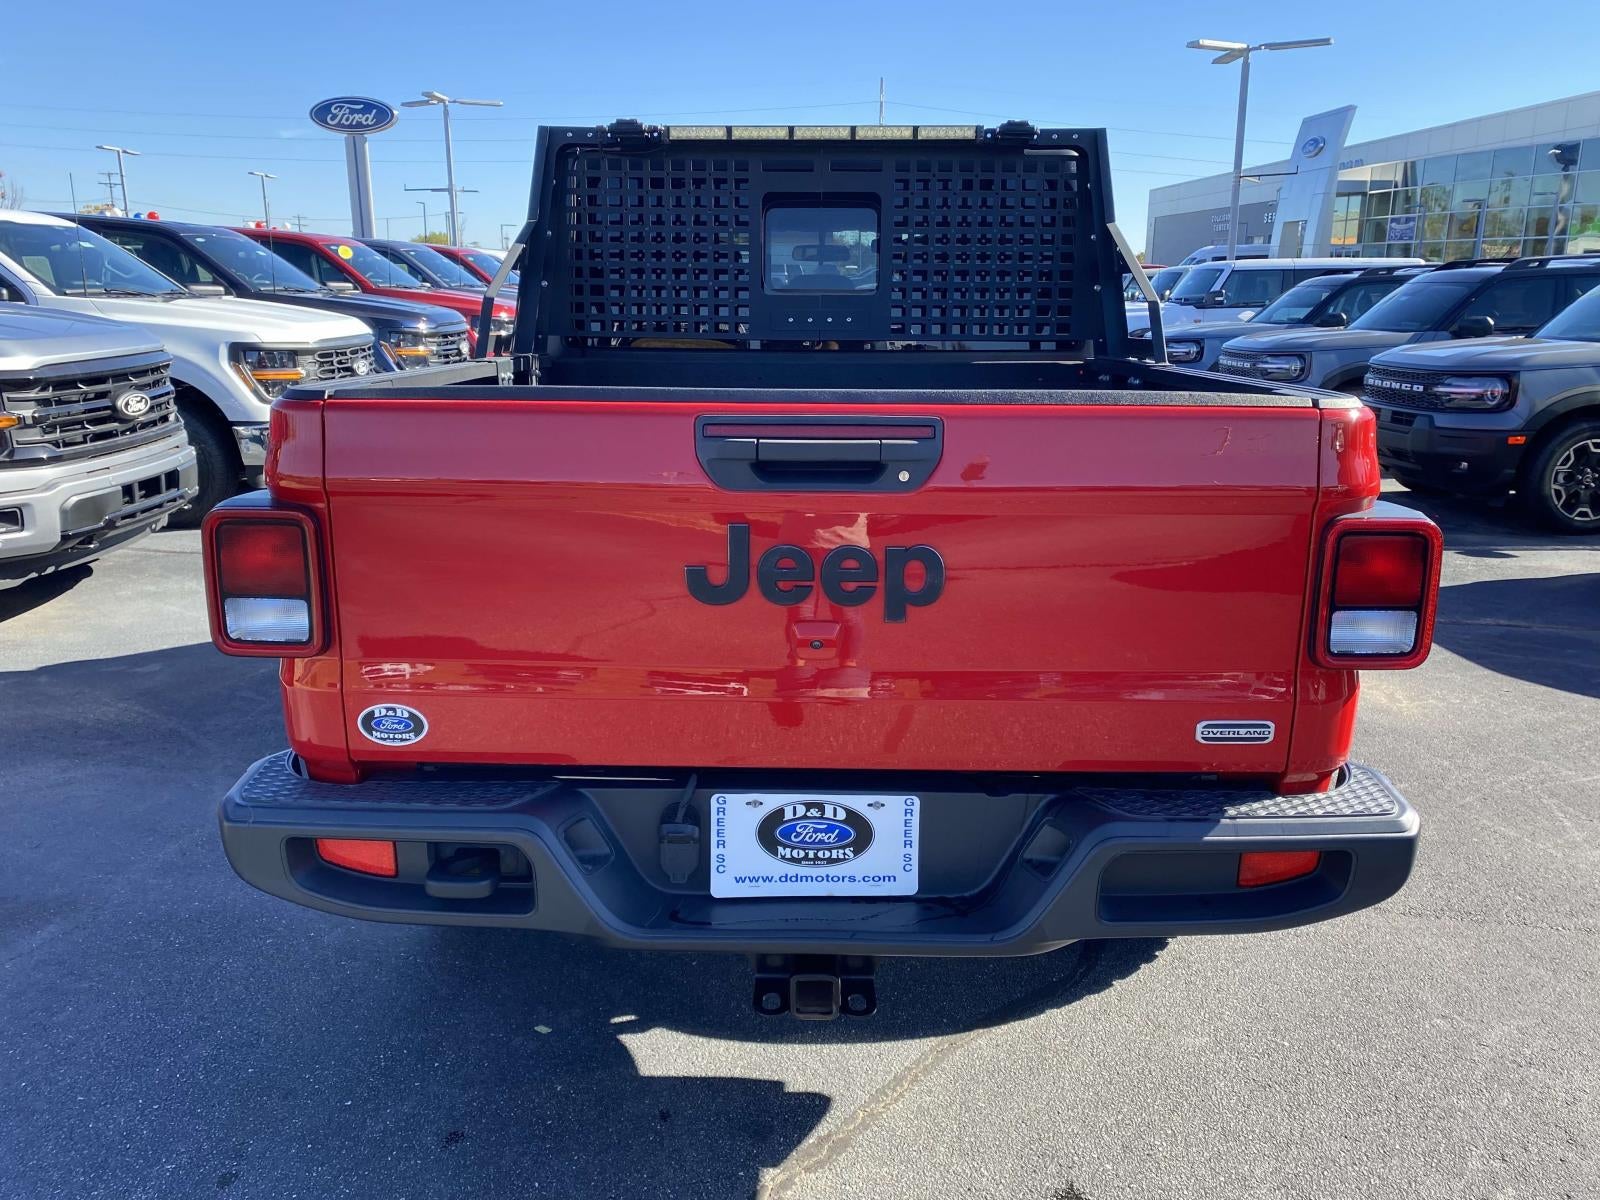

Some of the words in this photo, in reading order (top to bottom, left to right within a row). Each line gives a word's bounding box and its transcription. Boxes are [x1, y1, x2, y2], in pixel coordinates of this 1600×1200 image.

[327, 103, 377, 125] Ford
[1368, 378, 1424, 392] BRONCO
[127, 396, 146, 413] Ford
[684, 523, 946, 623] Jeep
[374, 708, 410, 718] D&D
[379, 718, 405, 730] Ford
[372, 731, 416, 740] MOTORS
[783, 804, 847, 821] D&D
[716, 795, 727, 849] GREER
[904, 798, 915, 849] GREER
[790, 823, 839, 844] Ford
[777, 846, 855, 860] MOTORS
[716, 853, 727, 874] SC
[903, 853, 913, 873] SC
[734, 873, 897, 884] www.ddmotors.com
